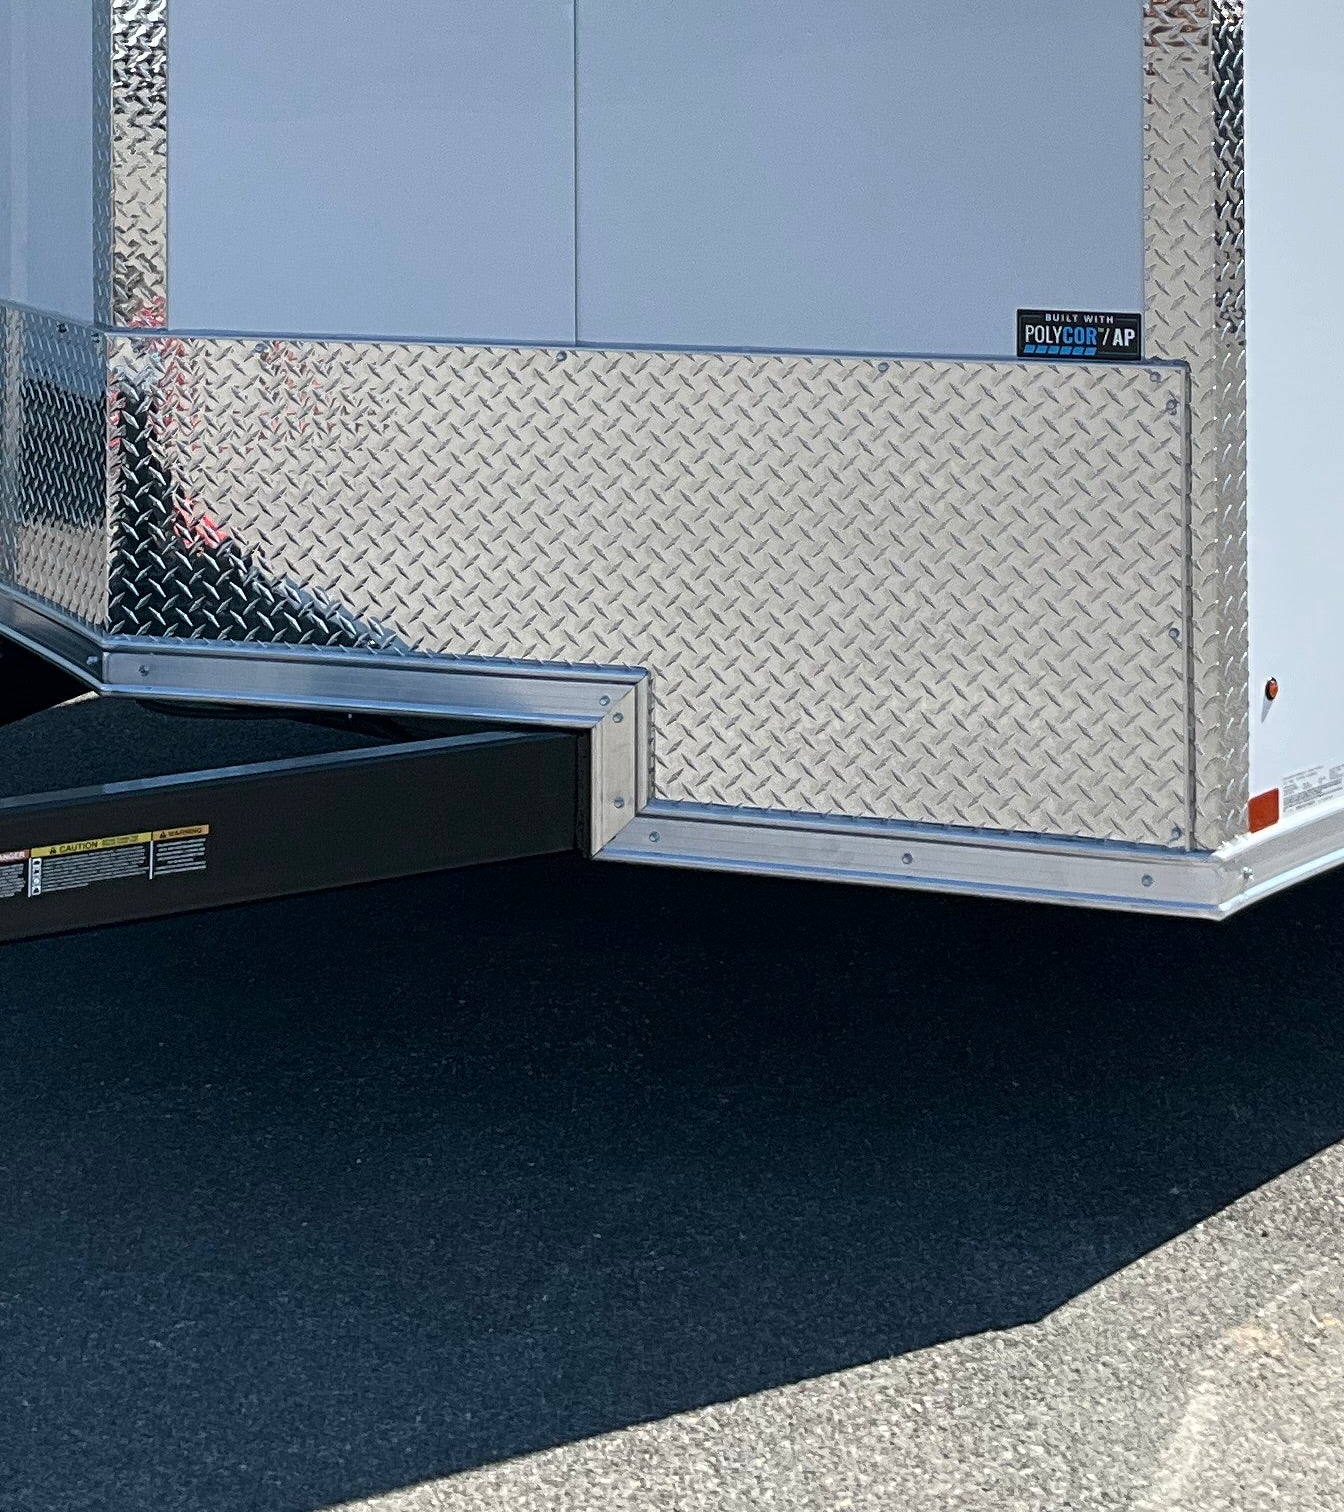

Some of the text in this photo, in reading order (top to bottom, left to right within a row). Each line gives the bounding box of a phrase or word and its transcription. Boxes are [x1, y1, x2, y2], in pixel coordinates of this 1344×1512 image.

[1045, 312, 1114, 325] BUILT WITH
[58, 841, 99, 854] CAUTION
